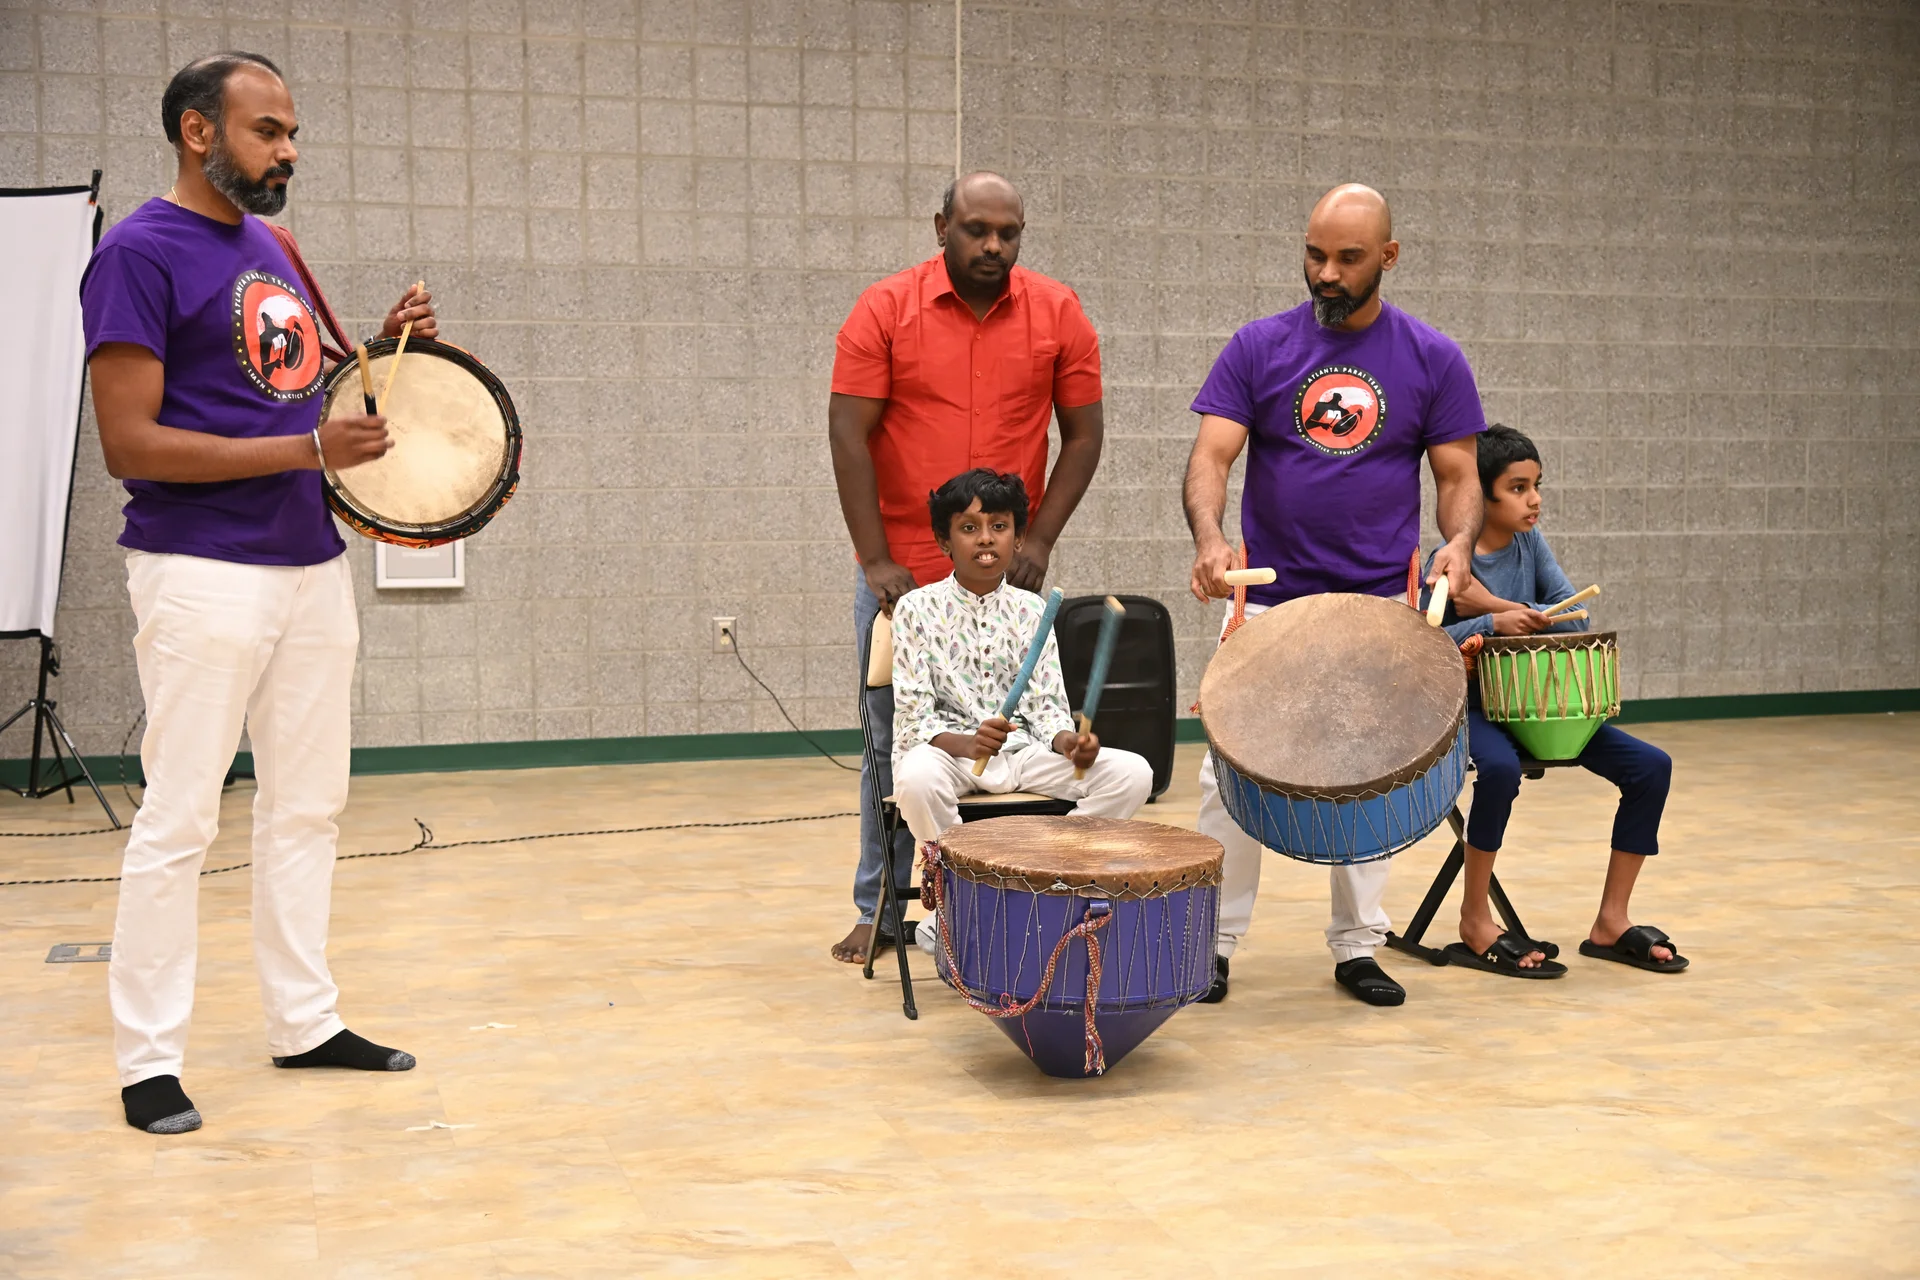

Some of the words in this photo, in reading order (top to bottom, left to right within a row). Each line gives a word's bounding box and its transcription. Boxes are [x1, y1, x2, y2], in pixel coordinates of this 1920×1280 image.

[235, 279, 246, 315] ATLANTA
[271, 277, 297, 294] TEAM
[247, 368, 265, 390] LEARN
[273, 391, 304, 399] PRACTICE
[1307, 367, 1339, 383] ATLANTA
[1342, 367, 1367, 378] PARAI
[1367, 377, 1382, 396] TEAM
[1339, 444, 1364, 455] EDUCATE
